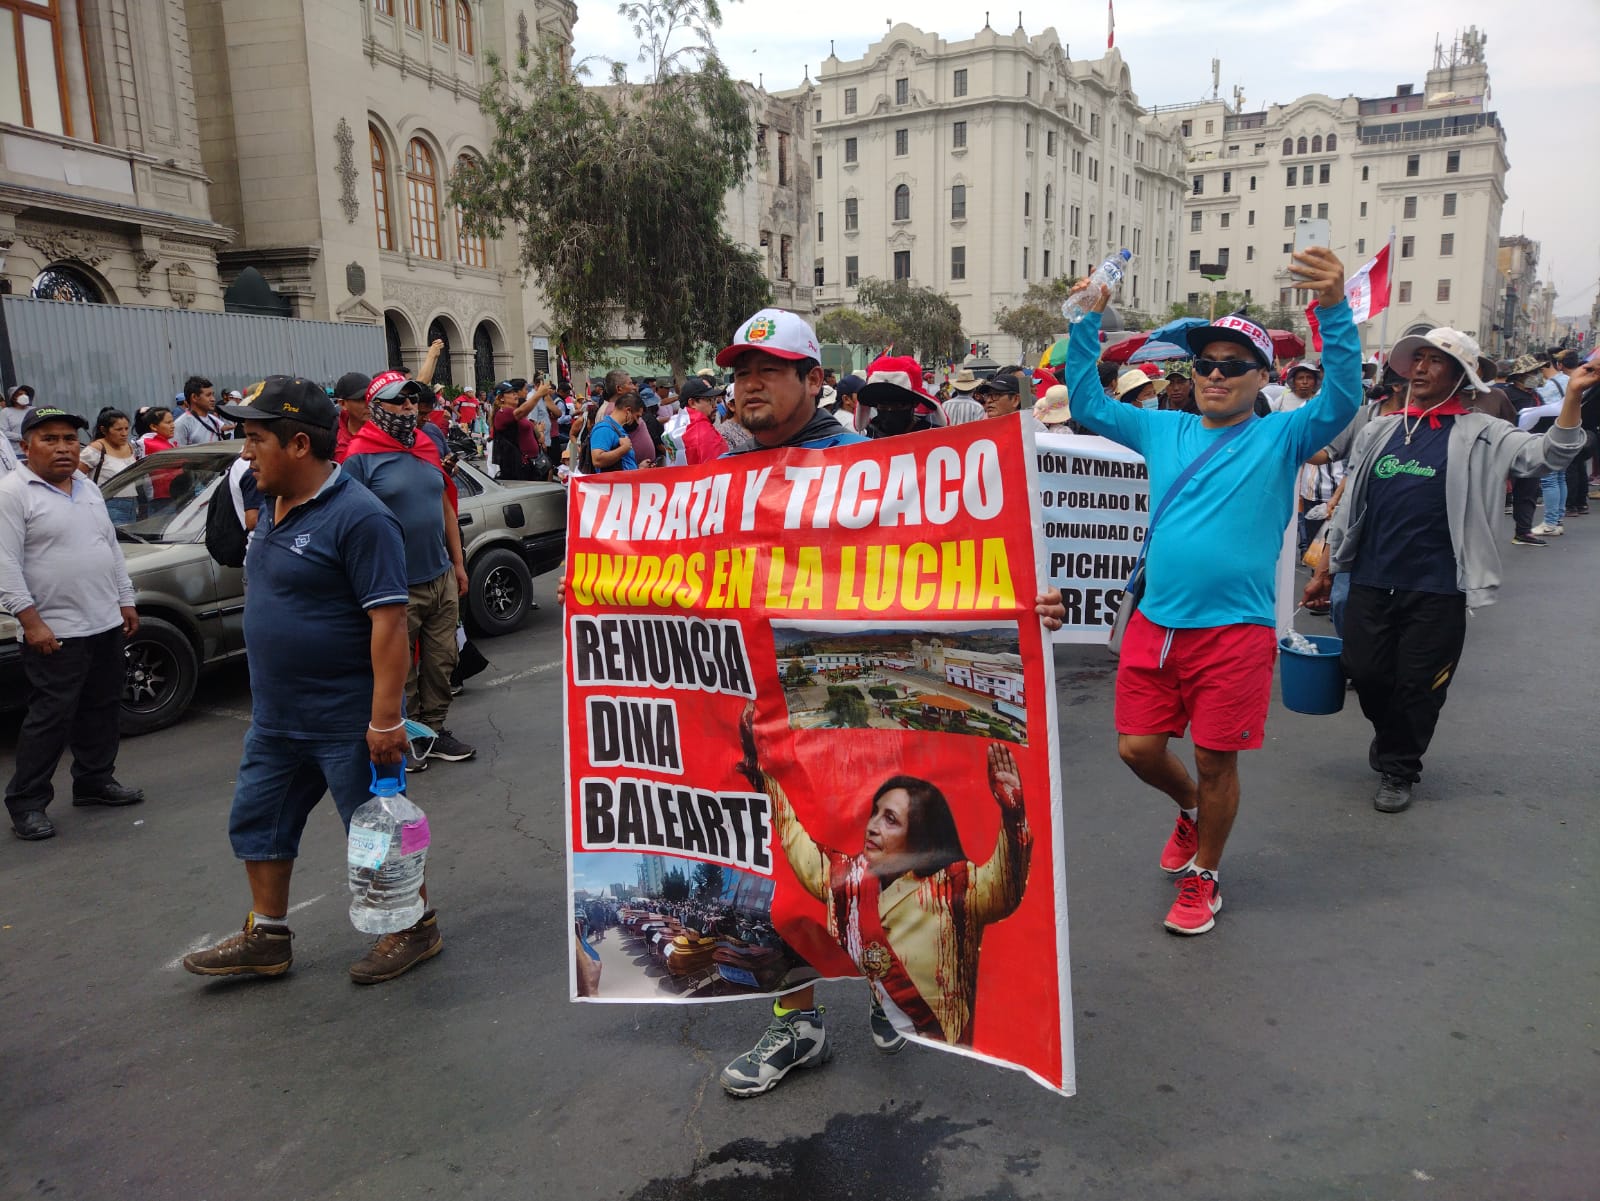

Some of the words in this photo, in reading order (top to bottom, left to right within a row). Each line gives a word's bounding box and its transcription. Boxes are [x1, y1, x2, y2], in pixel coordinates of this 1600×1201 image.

[578, 472, 732, 541] TARATA
[739, 465, 773, 531] Y
[784, 439, 1001, 530] TICACO
[1037, 452, 1067, 474] IÓN
[1072, 457, 1149, 480] AYMARA
[1057, 491, 1130, 511] POBLADO
[1043, 522, 1129, 541] OMUNIDAD
[571, 552, 706, 609] UNIDOS
[705, 546, 758, 610] EN
[764, 546, 825, 611] LA
[836, 537, 1017, 612] LUCHA
[1050, 552, 1146, 580] PICHIN
[1061, 588, 1125, 626] RES
[575, 619, 752, 694] RENUNCIA
[590, 700, 680, 769] DINA
[584, 782, 770, 868] BALEARTE
